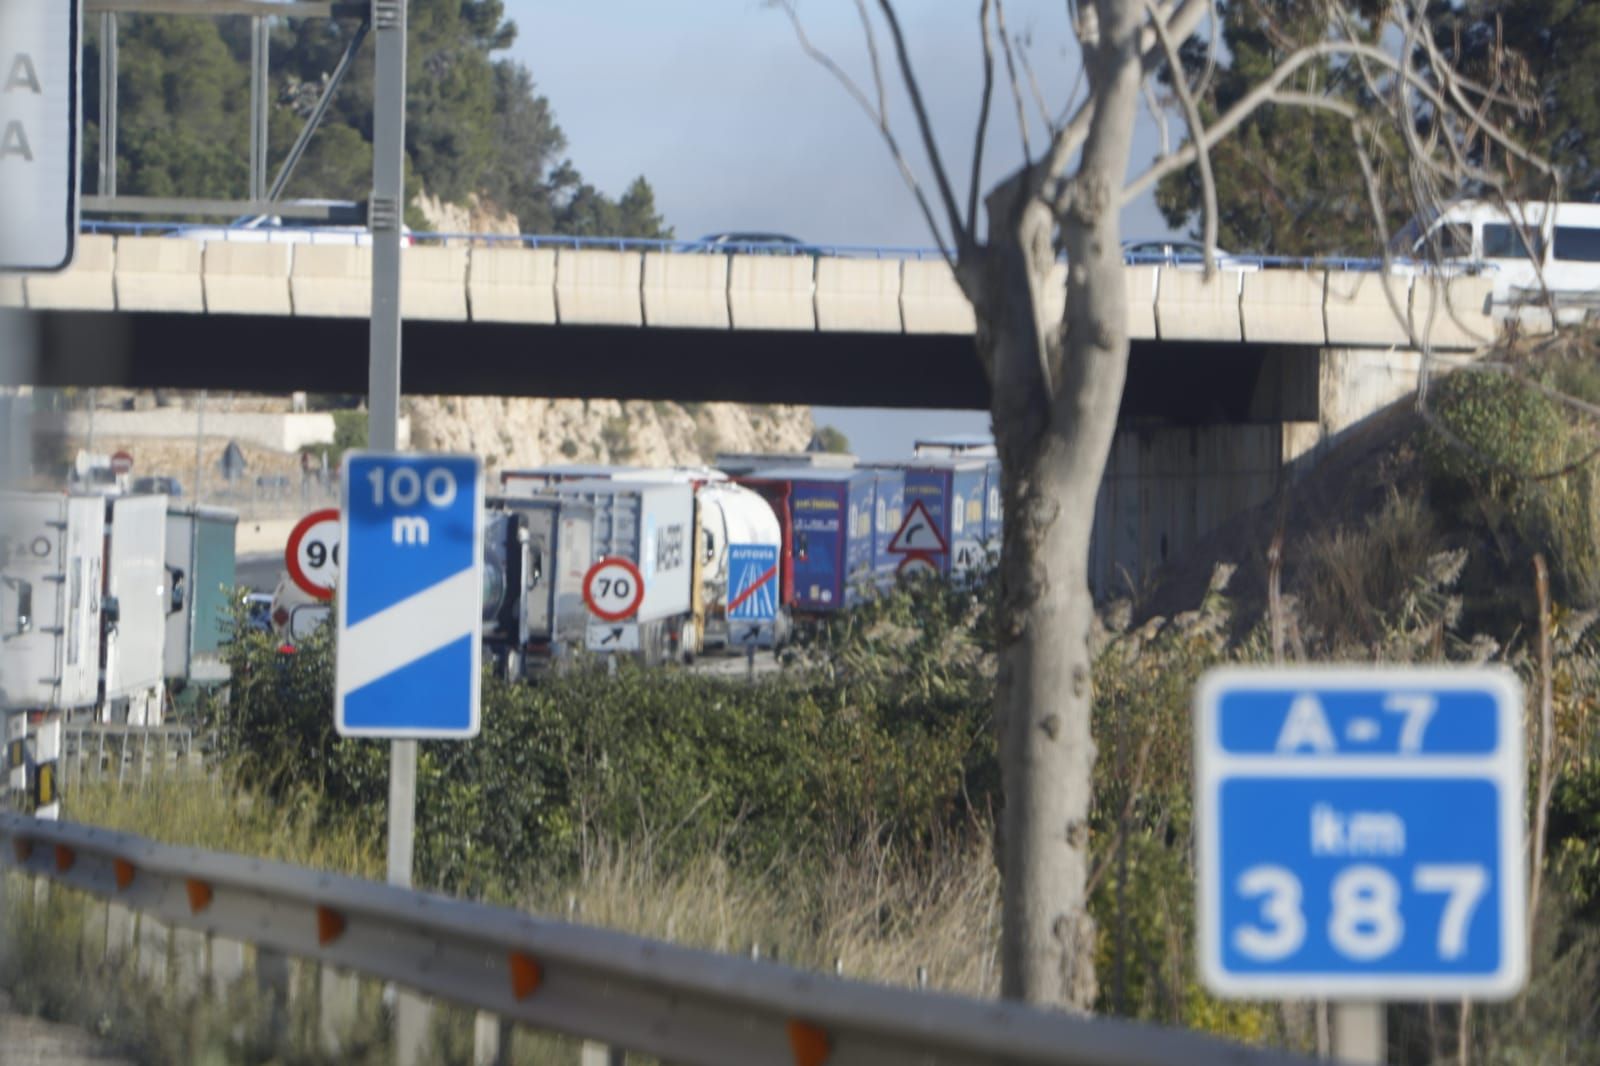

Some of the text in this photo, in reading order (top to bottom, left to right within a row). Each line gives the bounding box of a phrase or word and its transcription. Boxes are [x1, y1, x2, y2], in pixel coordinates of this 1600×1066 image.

[368, 467, 457, 507] 100
[392, 516, 429, 544] m
[598, 577, 630, 598] 70
[1275, 692, 1439, 755] A-7
[1311, 804, 1406, 856] km
[1234, 863, 1489, 962] 387
